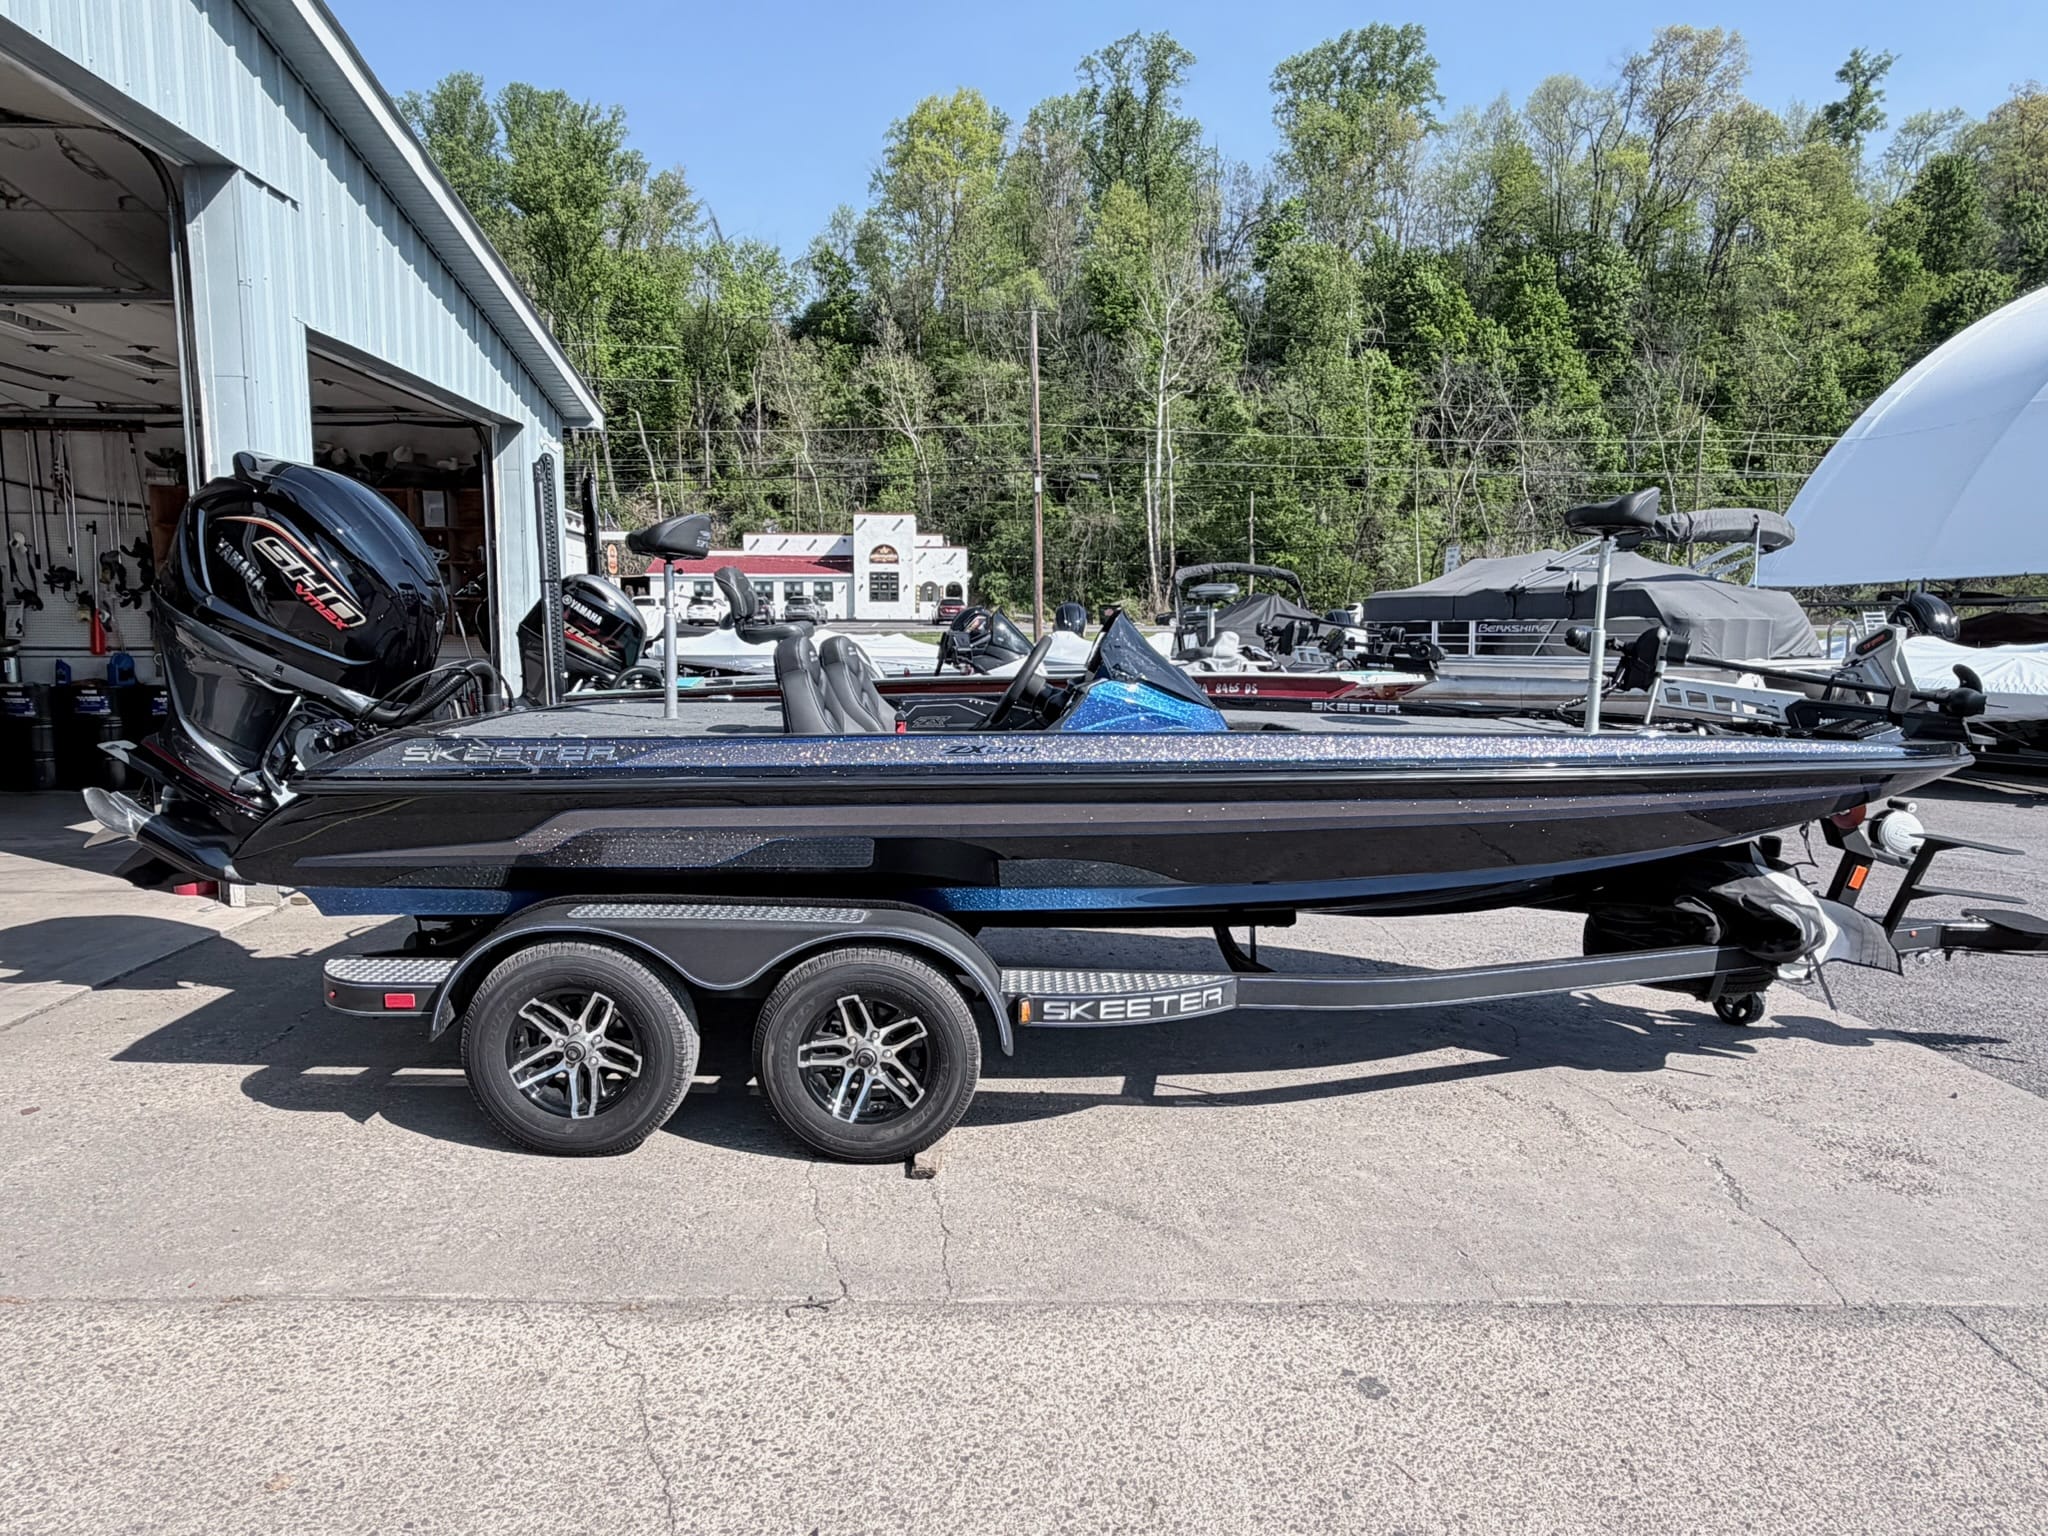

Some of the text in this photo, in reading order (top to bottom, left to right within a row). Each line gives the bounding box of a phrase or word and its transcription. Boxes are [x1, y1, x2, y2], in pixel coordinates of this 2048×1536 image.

[215, 537, 266, 591] YAMAHA
[252, 536, 367, 628] SHO
[570, 598, 603, 626] YAMAHA
[1478, 623, 1550, 633] BERKSHIRE
[1311, 701, 1400, 714] SKEETER
[402, 745, 618, 762] SKEETER
[1043, 987, 1222, 1021] SKEETER
